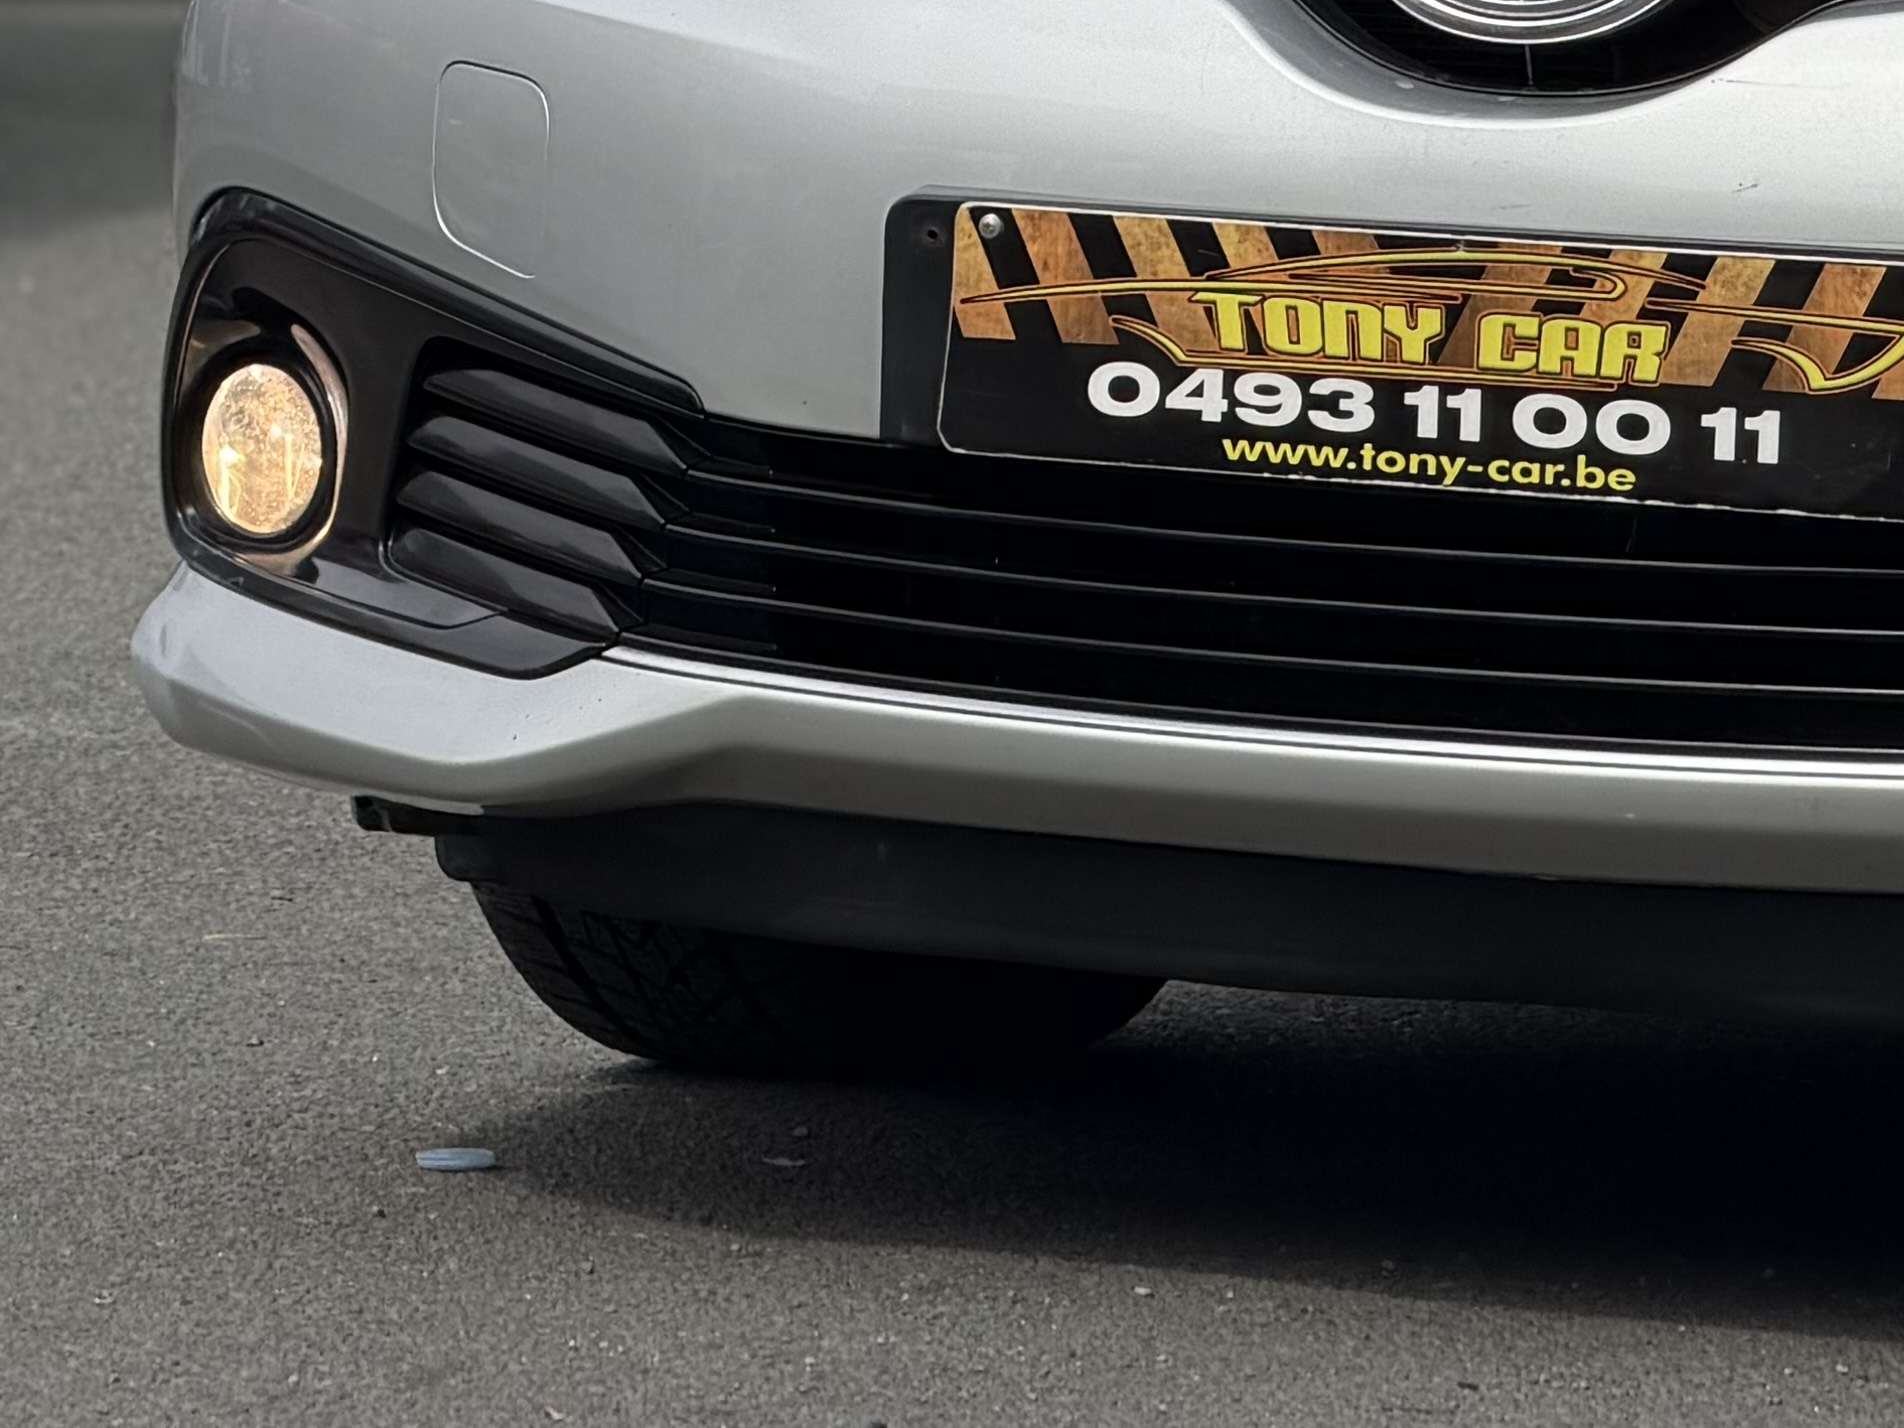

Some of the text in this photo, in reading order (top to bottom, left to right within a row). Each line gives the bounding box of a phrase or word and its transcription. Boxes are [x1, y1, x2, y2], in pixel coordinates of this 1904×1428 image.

[1190, 291, 1670, 384] TONY CAR
[1087, 360, 1781, 464] 0493 11 00 11
[1221, 436, 1637, 492] www.tony-car.be
